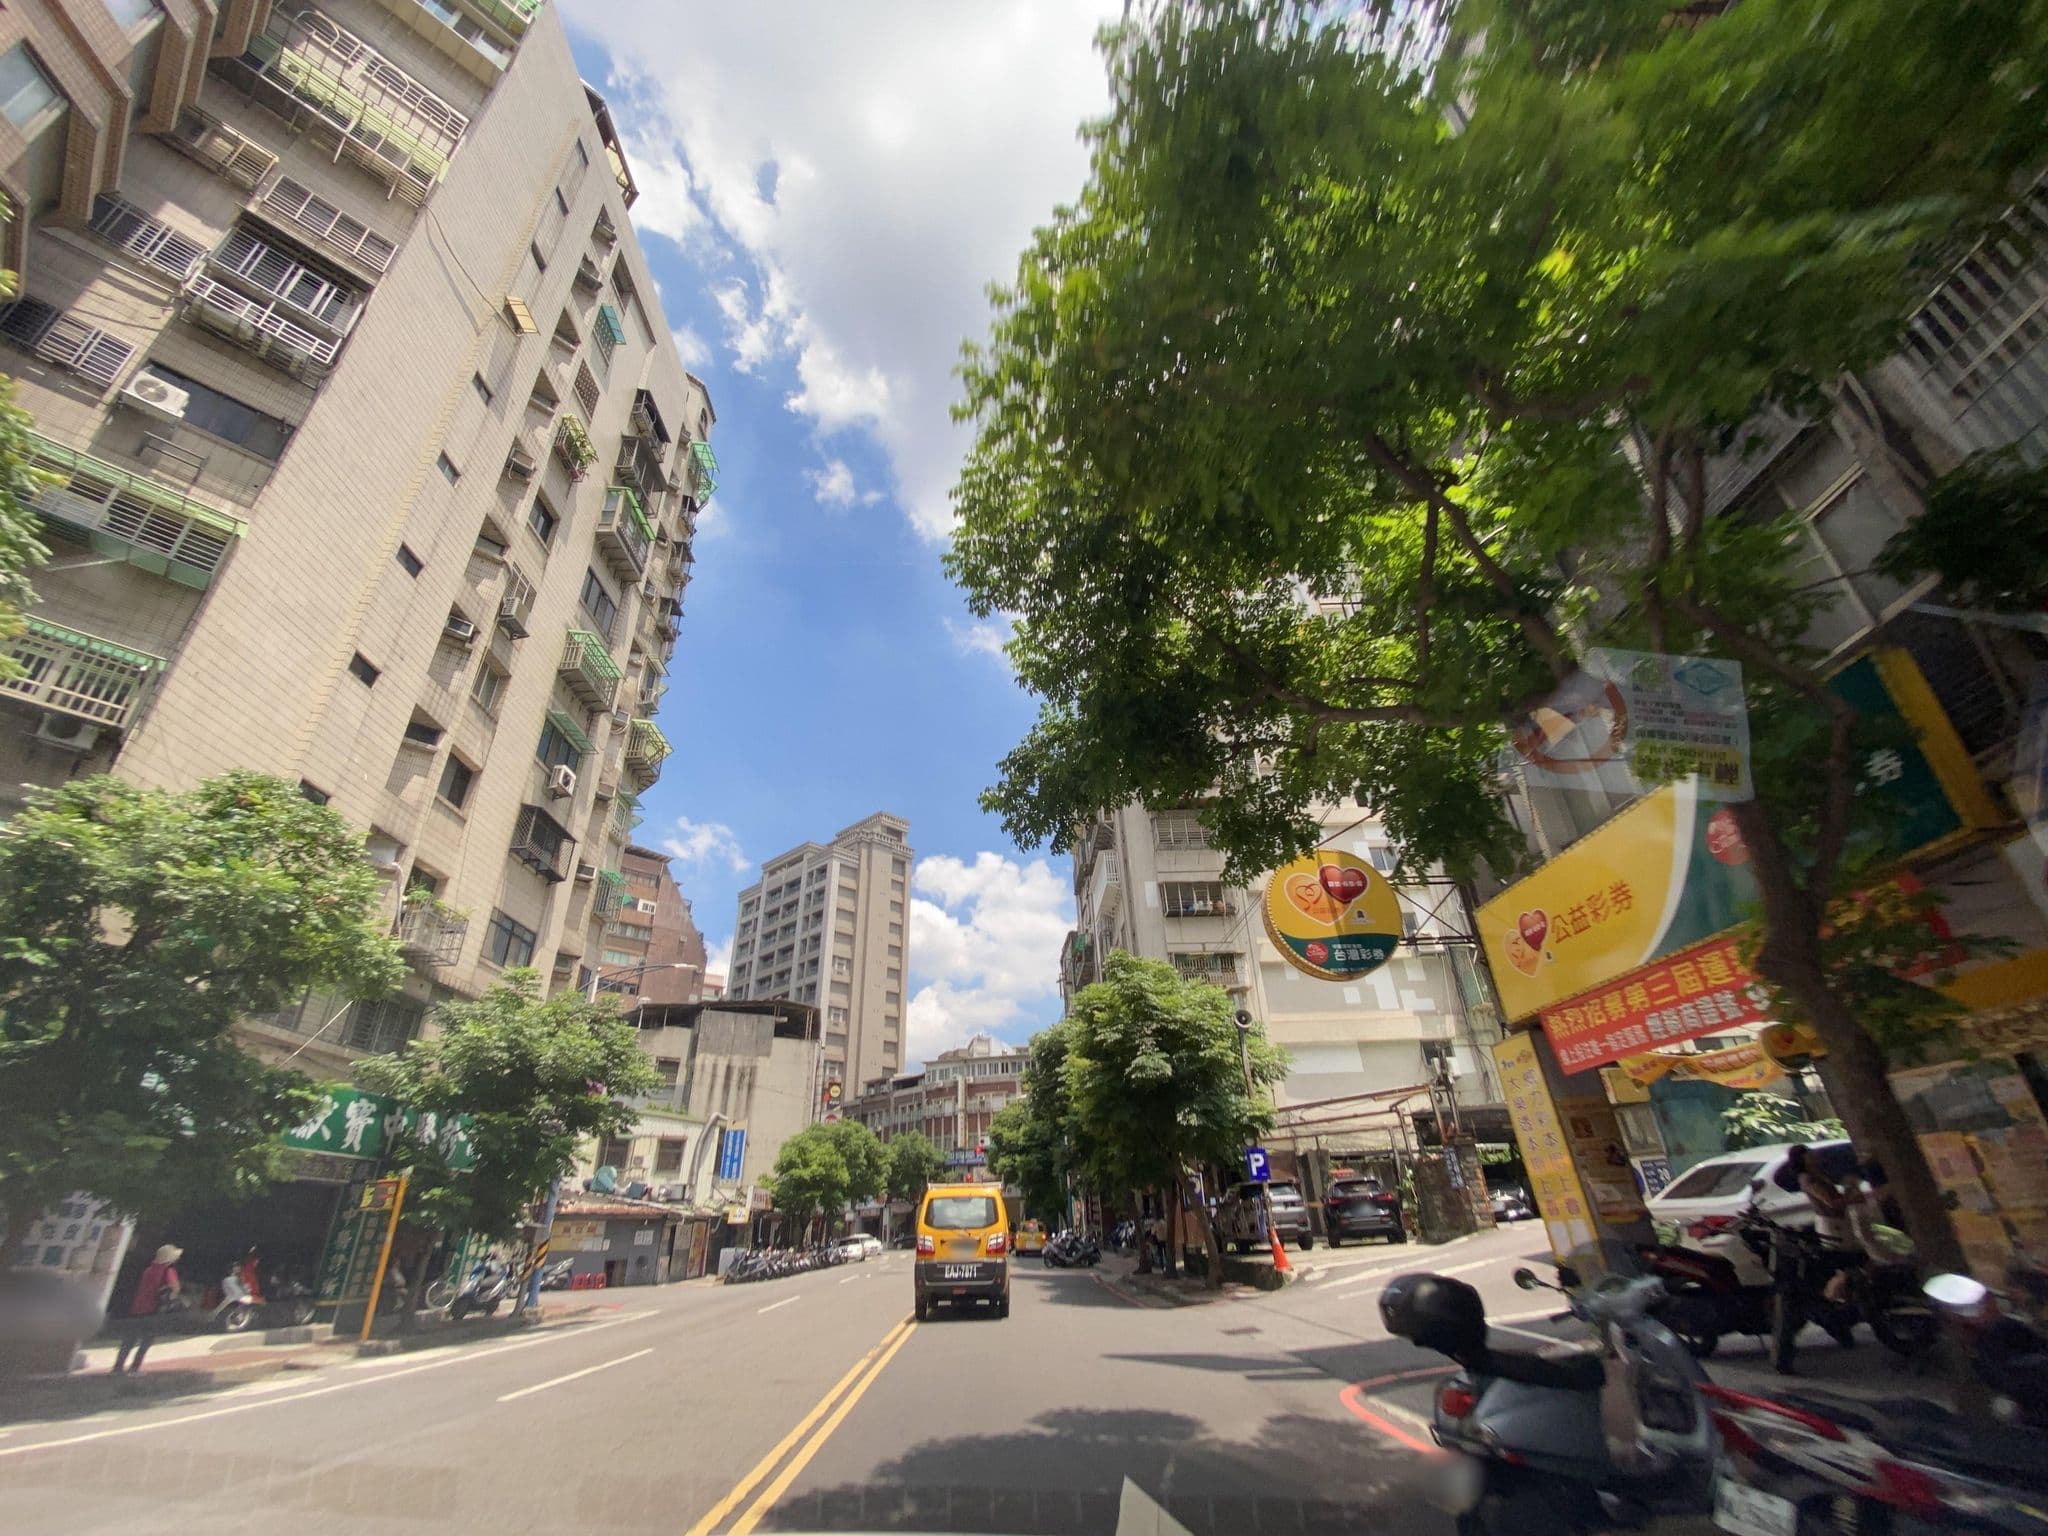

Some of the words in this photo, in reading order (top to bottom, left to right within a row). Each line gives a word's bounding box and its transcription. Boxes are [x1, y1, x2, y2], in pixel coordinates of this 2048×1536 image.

[1550, 880, 1633, 944] 公益彩券
[1333, 948, 1384, 961] 台灣彩券
[1249, 1153, 1265, 1176] P
